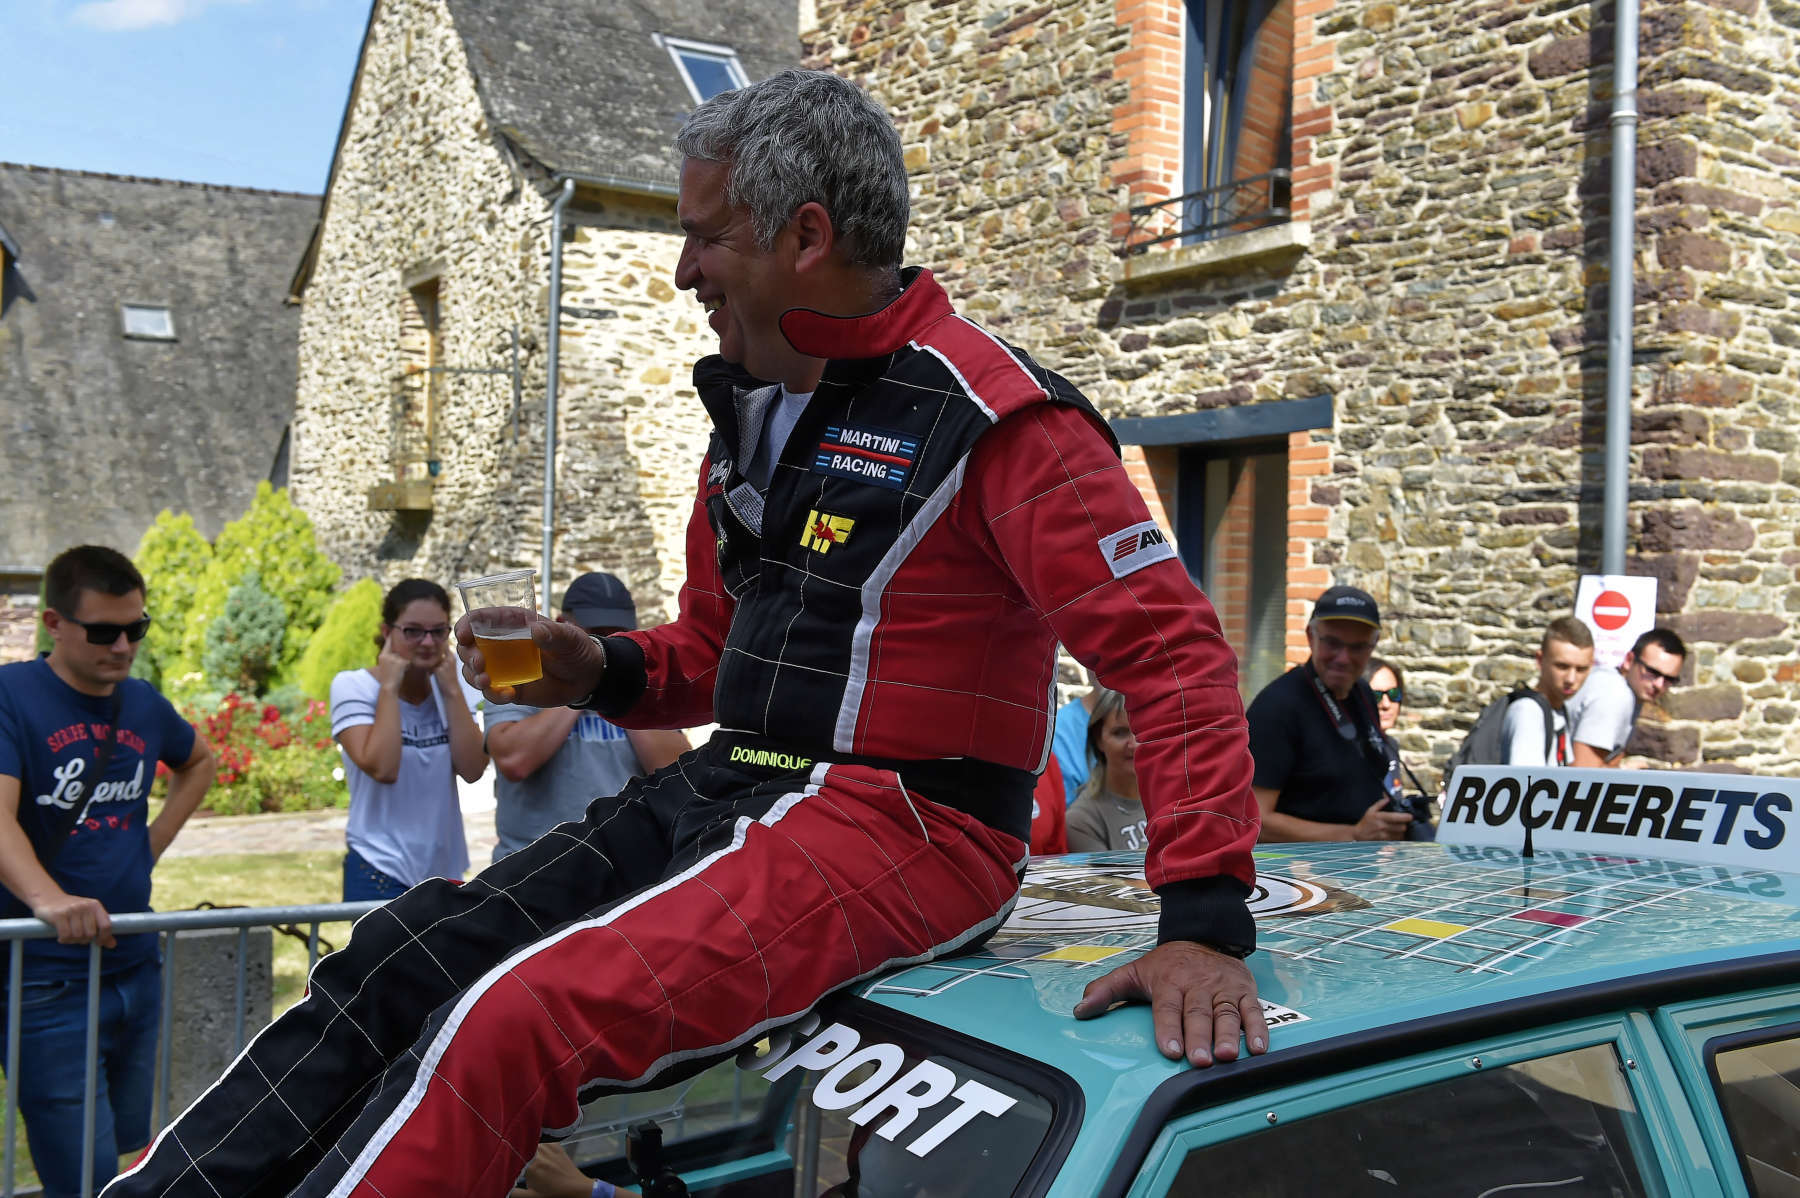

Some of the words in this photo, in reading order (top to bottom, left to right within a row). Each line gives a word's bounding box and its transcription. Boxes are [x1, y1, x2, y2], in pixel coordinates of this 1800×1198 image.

[839, 428, 901, 455] MARTINI
[831, 454, 888, 479] RACING
[799, 509, 856, 555] HF
[730, 746, 812, 770] DOMINIQUE
[1446, 776, 1793, 850] ROCHERETS
[735, 1012, 1018, 1158] SPORT
